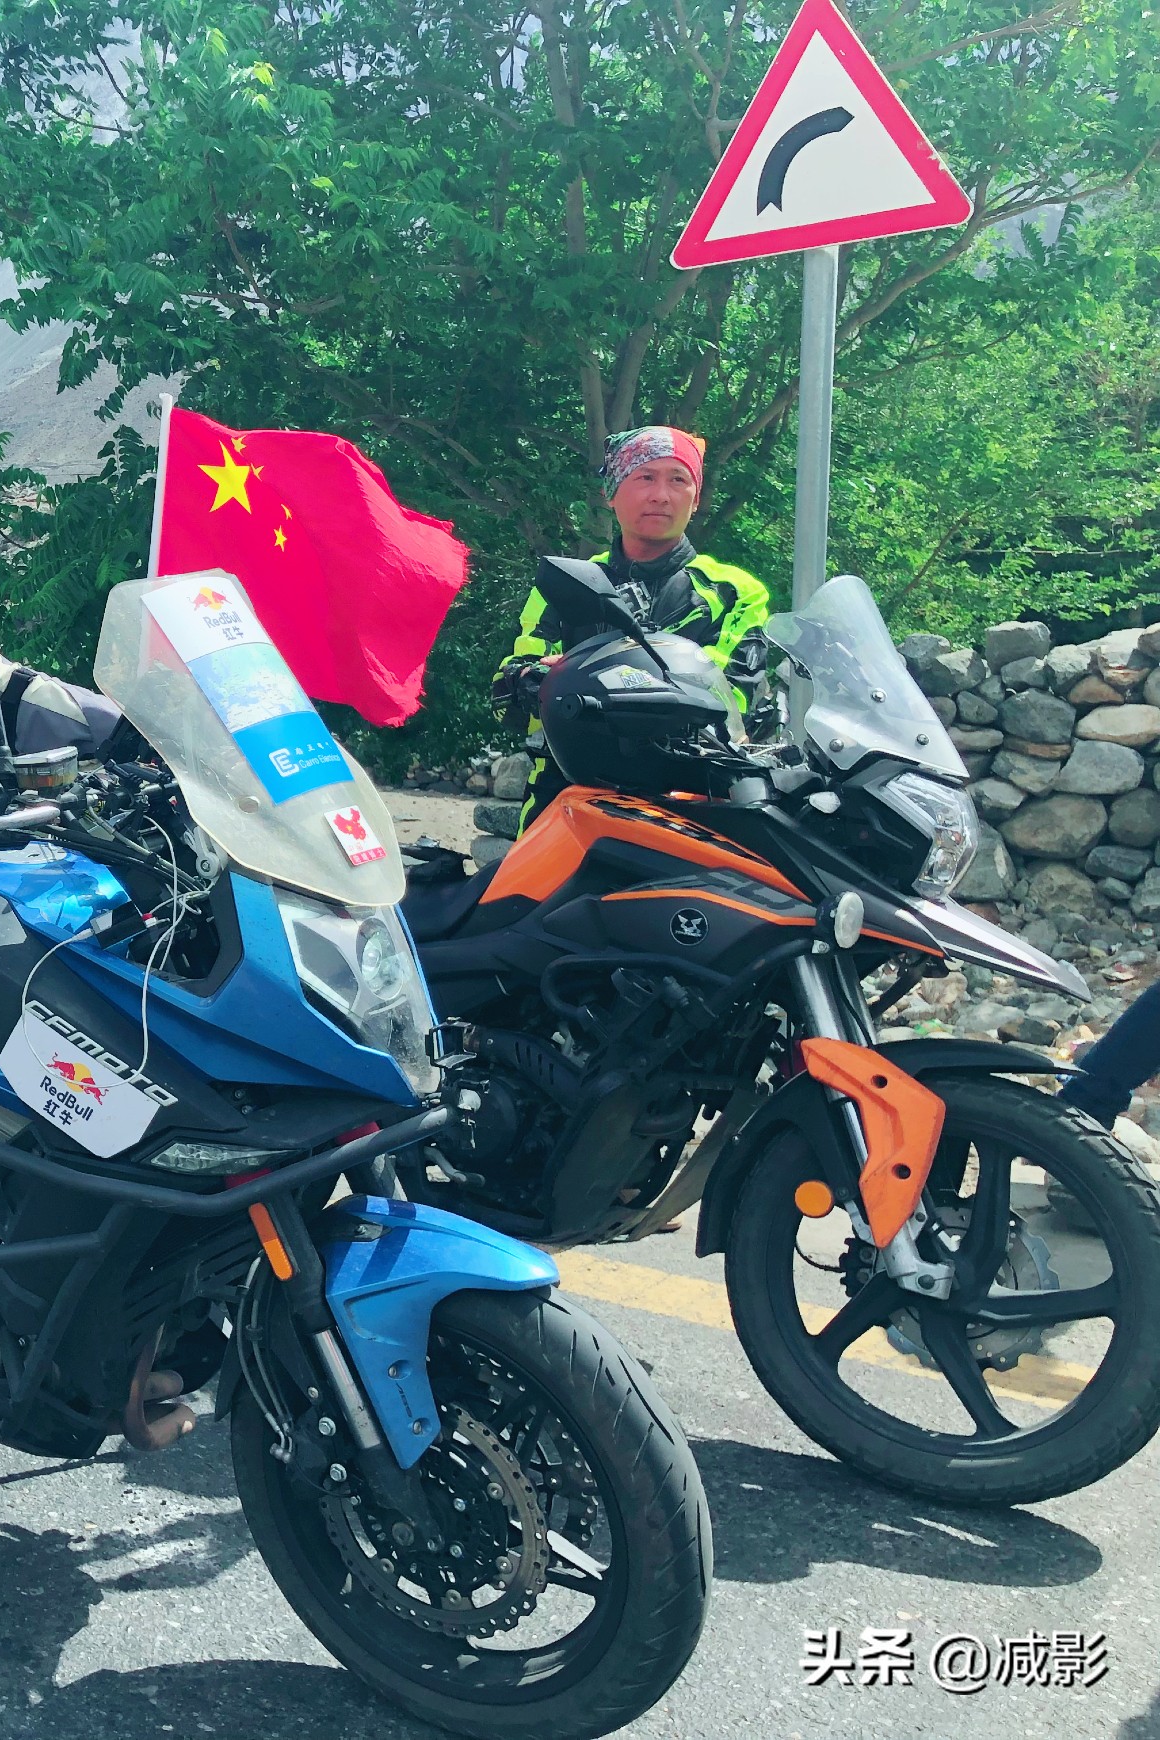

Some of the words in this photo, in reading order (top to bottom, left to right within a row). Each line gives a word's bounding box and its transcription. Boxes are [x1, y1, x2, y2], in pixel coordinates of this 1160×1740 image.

[202, 611, 242, 628] RedBull
[222, 626, 244, 640] 红牛
[40, 1075, 94, 1121] RedBull
[43, 1099, 73, 1125] 红牛
